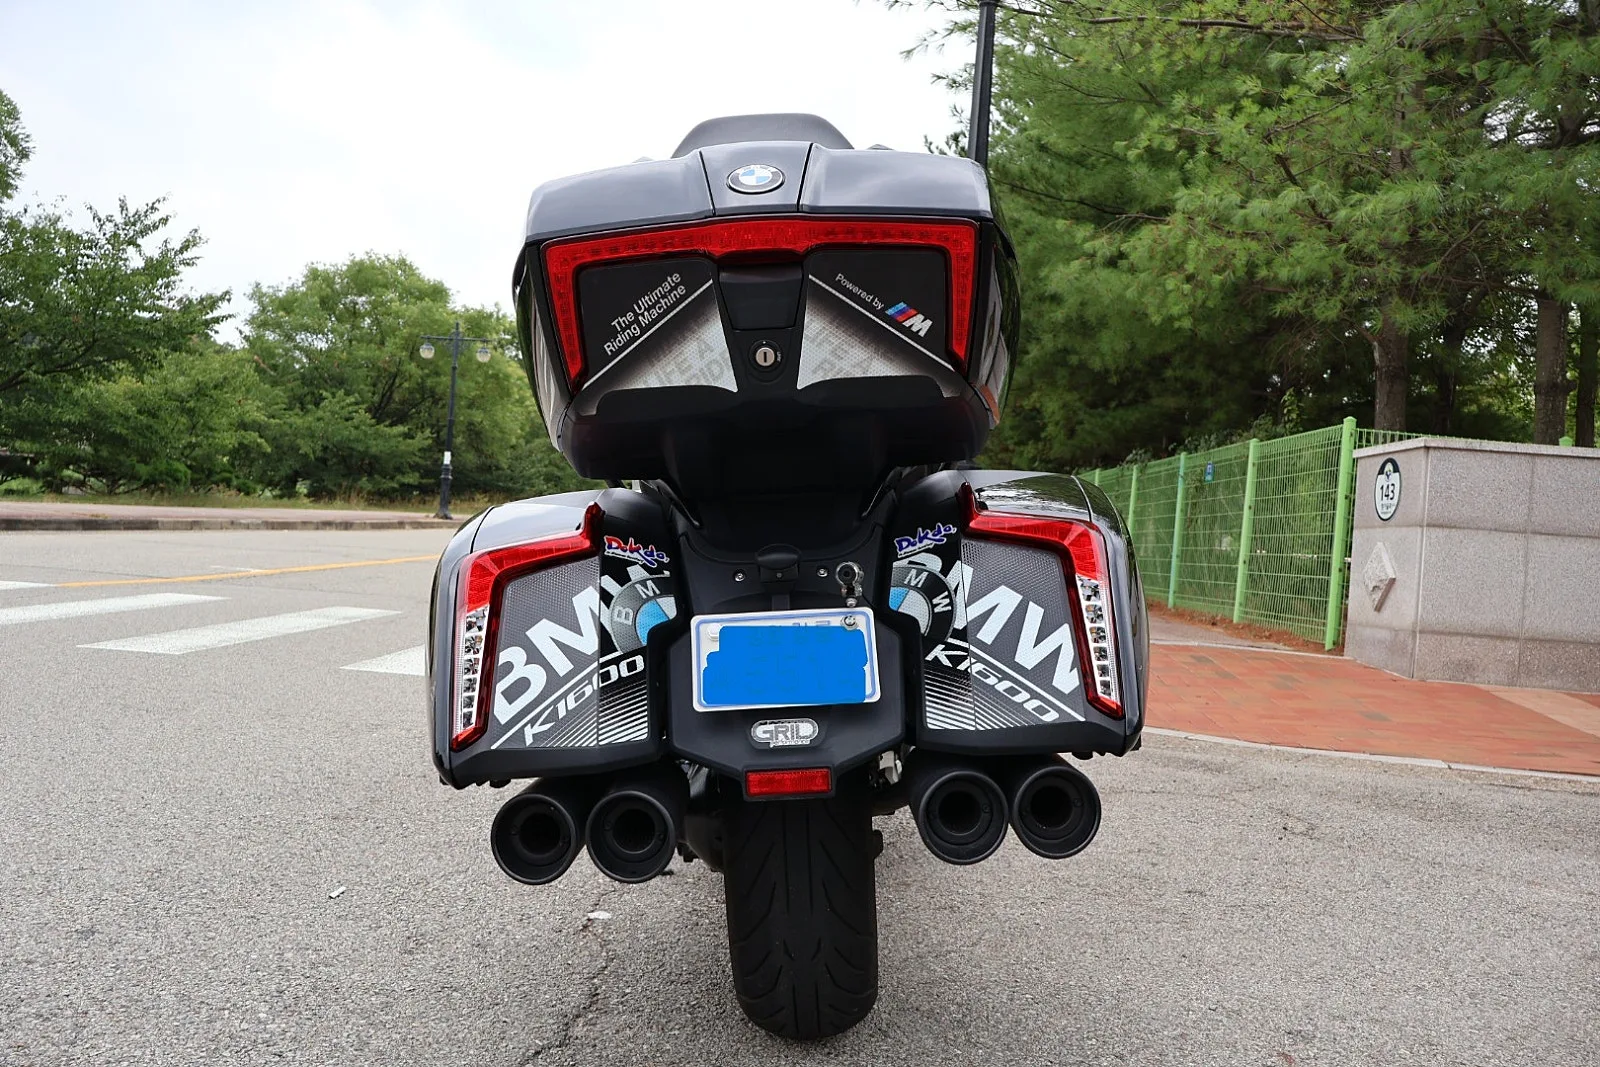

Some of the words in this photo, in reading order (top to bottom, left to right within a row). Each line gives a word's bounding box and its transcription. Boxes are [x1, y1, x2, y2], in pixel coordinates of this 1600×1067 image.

[603, 322, 641, 356] Riding
[638, 285, 687, 327] Machine
[611, 311, 635, 331] The
[633, 273, 681, 314] Ultimate
[835, 273, 874, 302] Powered
[872, 297, 885, 310] by
[901, 313, 933, 338] M
[1379, 483, 1396, 501] 143
[524, 654, 645, 747] K1600
[924, 644, 1060, 722] K1600
